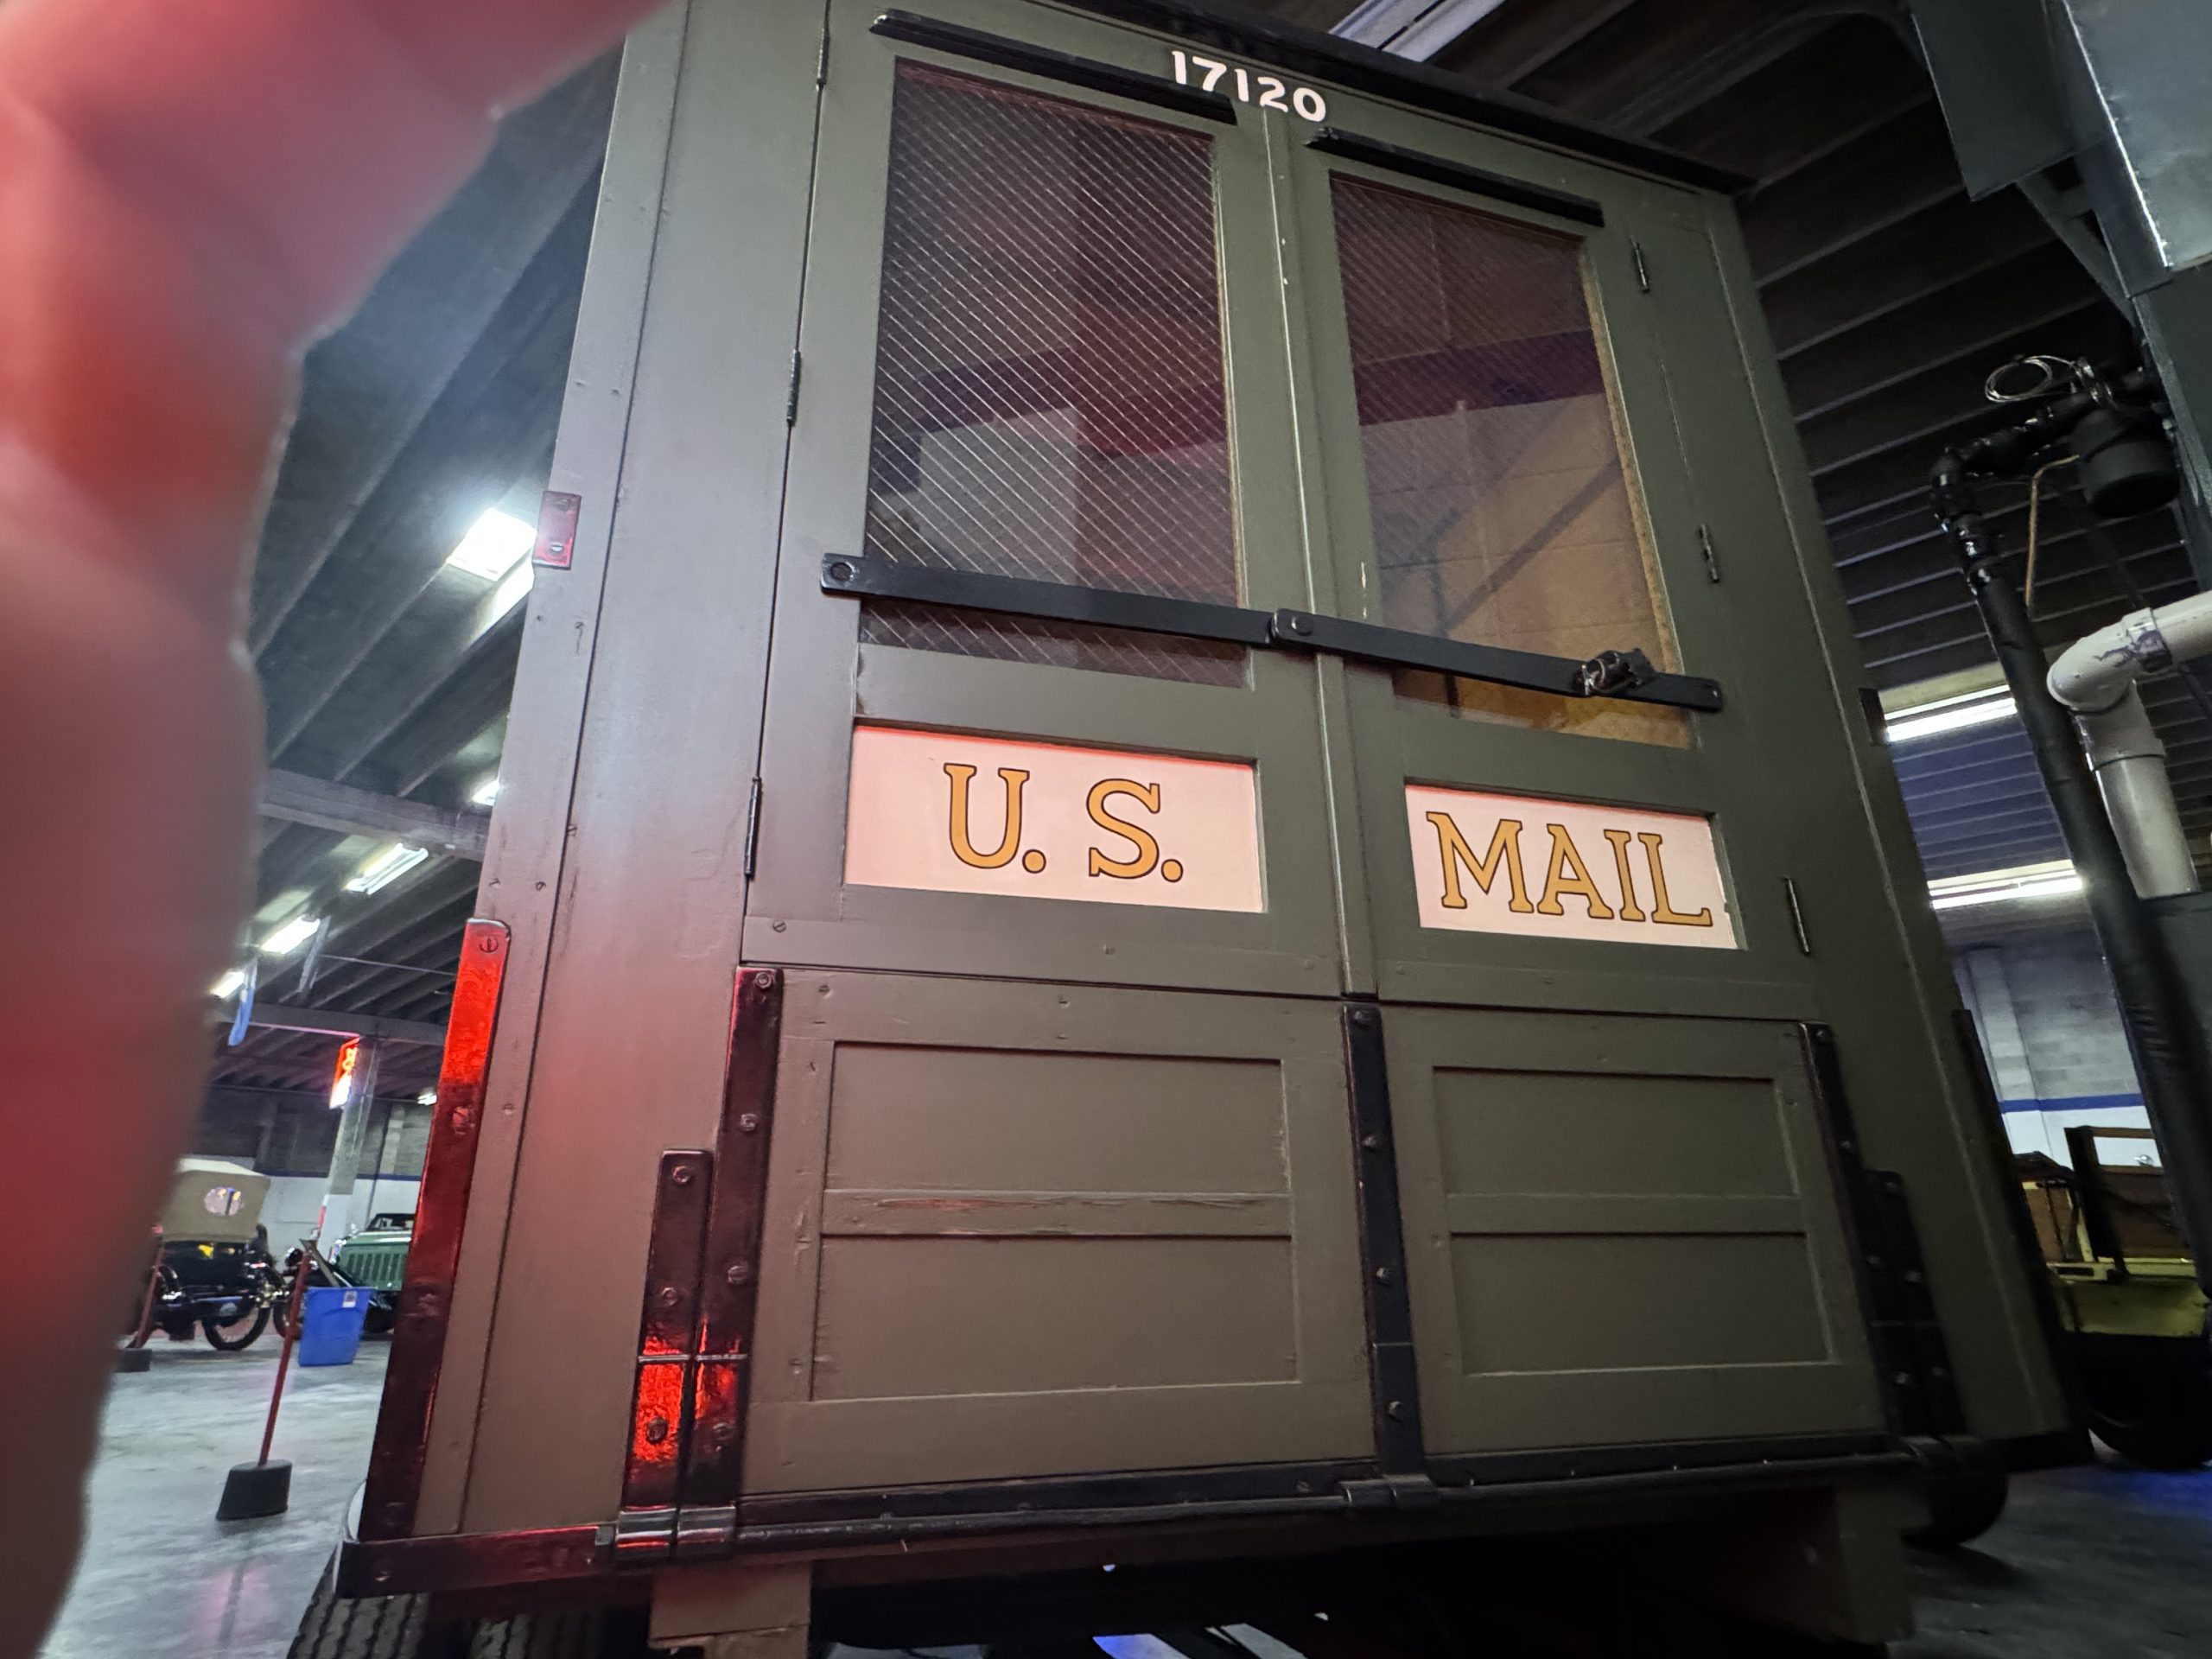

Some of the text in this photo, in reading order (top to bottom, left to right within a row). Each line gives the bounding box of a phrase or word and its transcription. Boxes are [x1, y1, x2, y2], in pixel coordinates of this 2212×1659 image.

[1172, 50, 1326, 122] 17120
[944, 762, 1713, 926] U. S. MAIL
